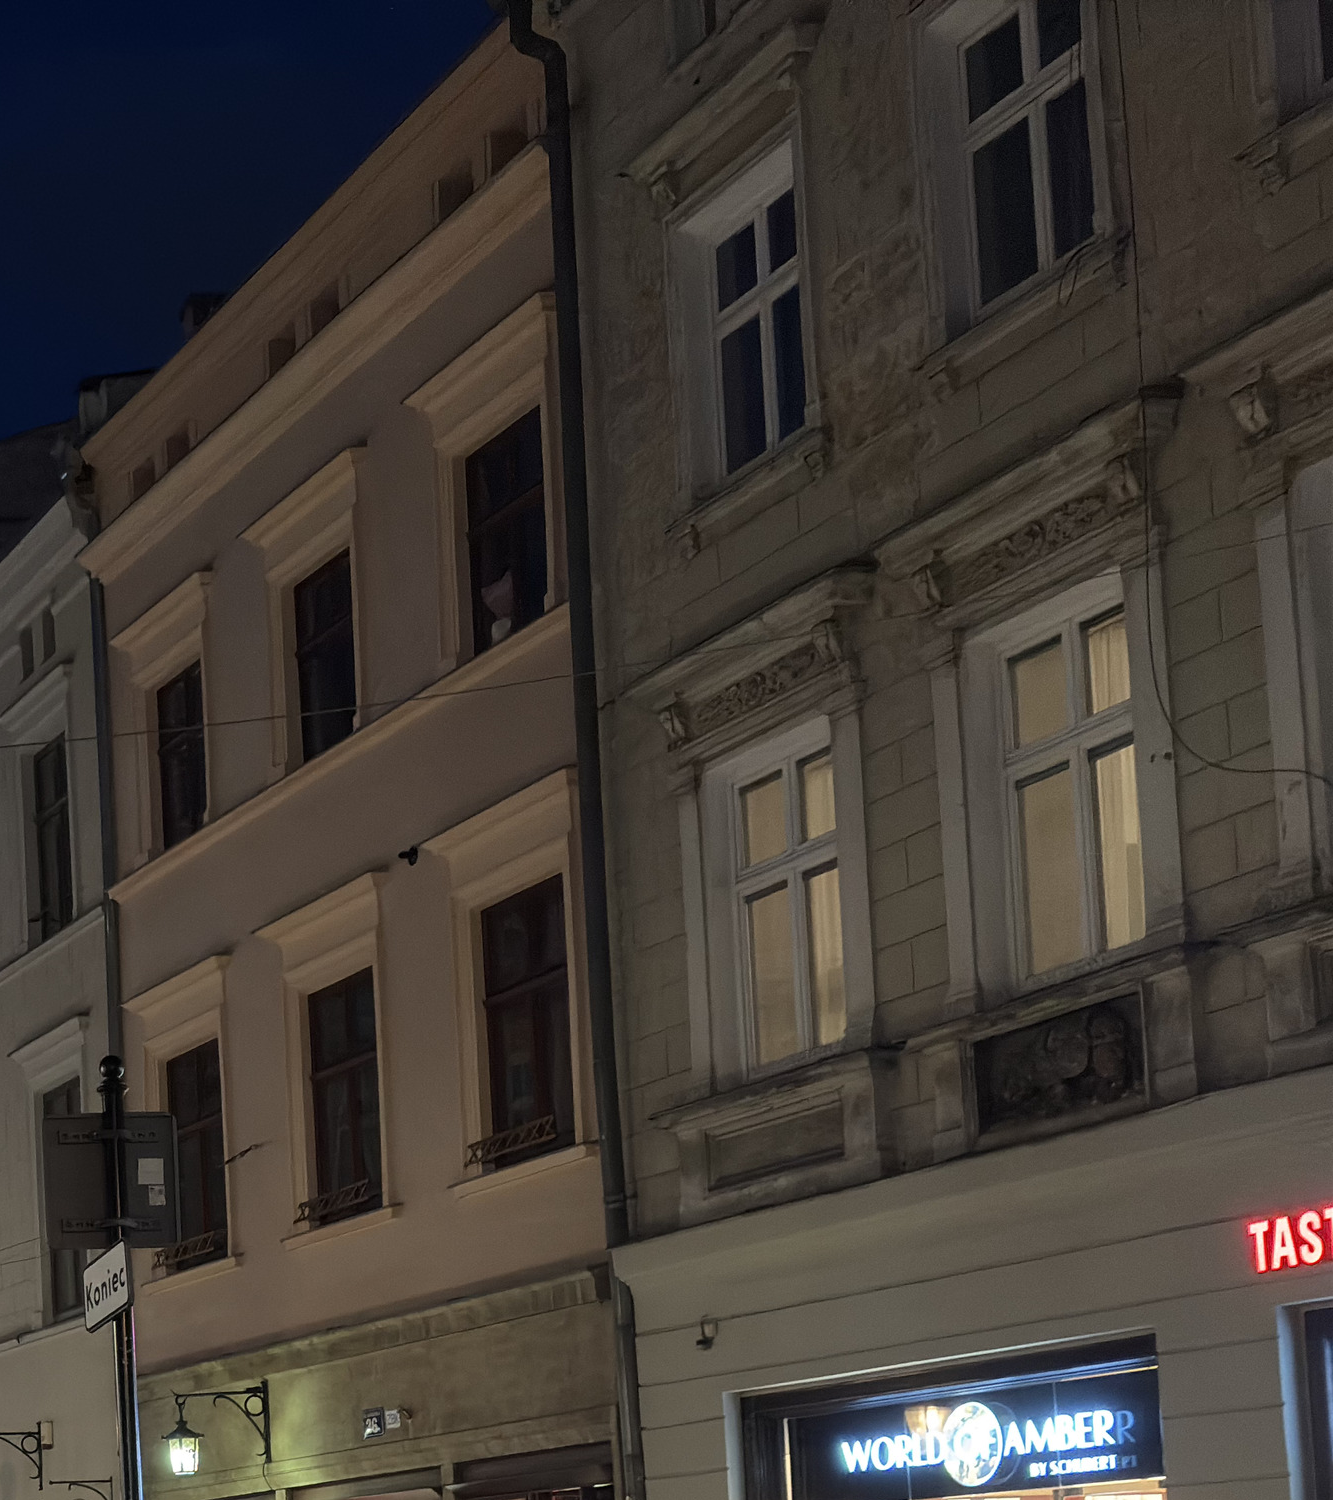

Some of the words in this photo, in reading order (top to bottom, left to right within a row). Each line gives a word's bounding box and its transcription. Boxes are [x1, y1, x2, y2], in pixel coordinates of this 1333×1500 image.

[86, 1267, 126, 1312] Koniec
[841, 1430, 947, 1473] WORLD
[1003, 1409, 1118, 1457] AMBER
[1030, 1462, 1048, 1478] BY
